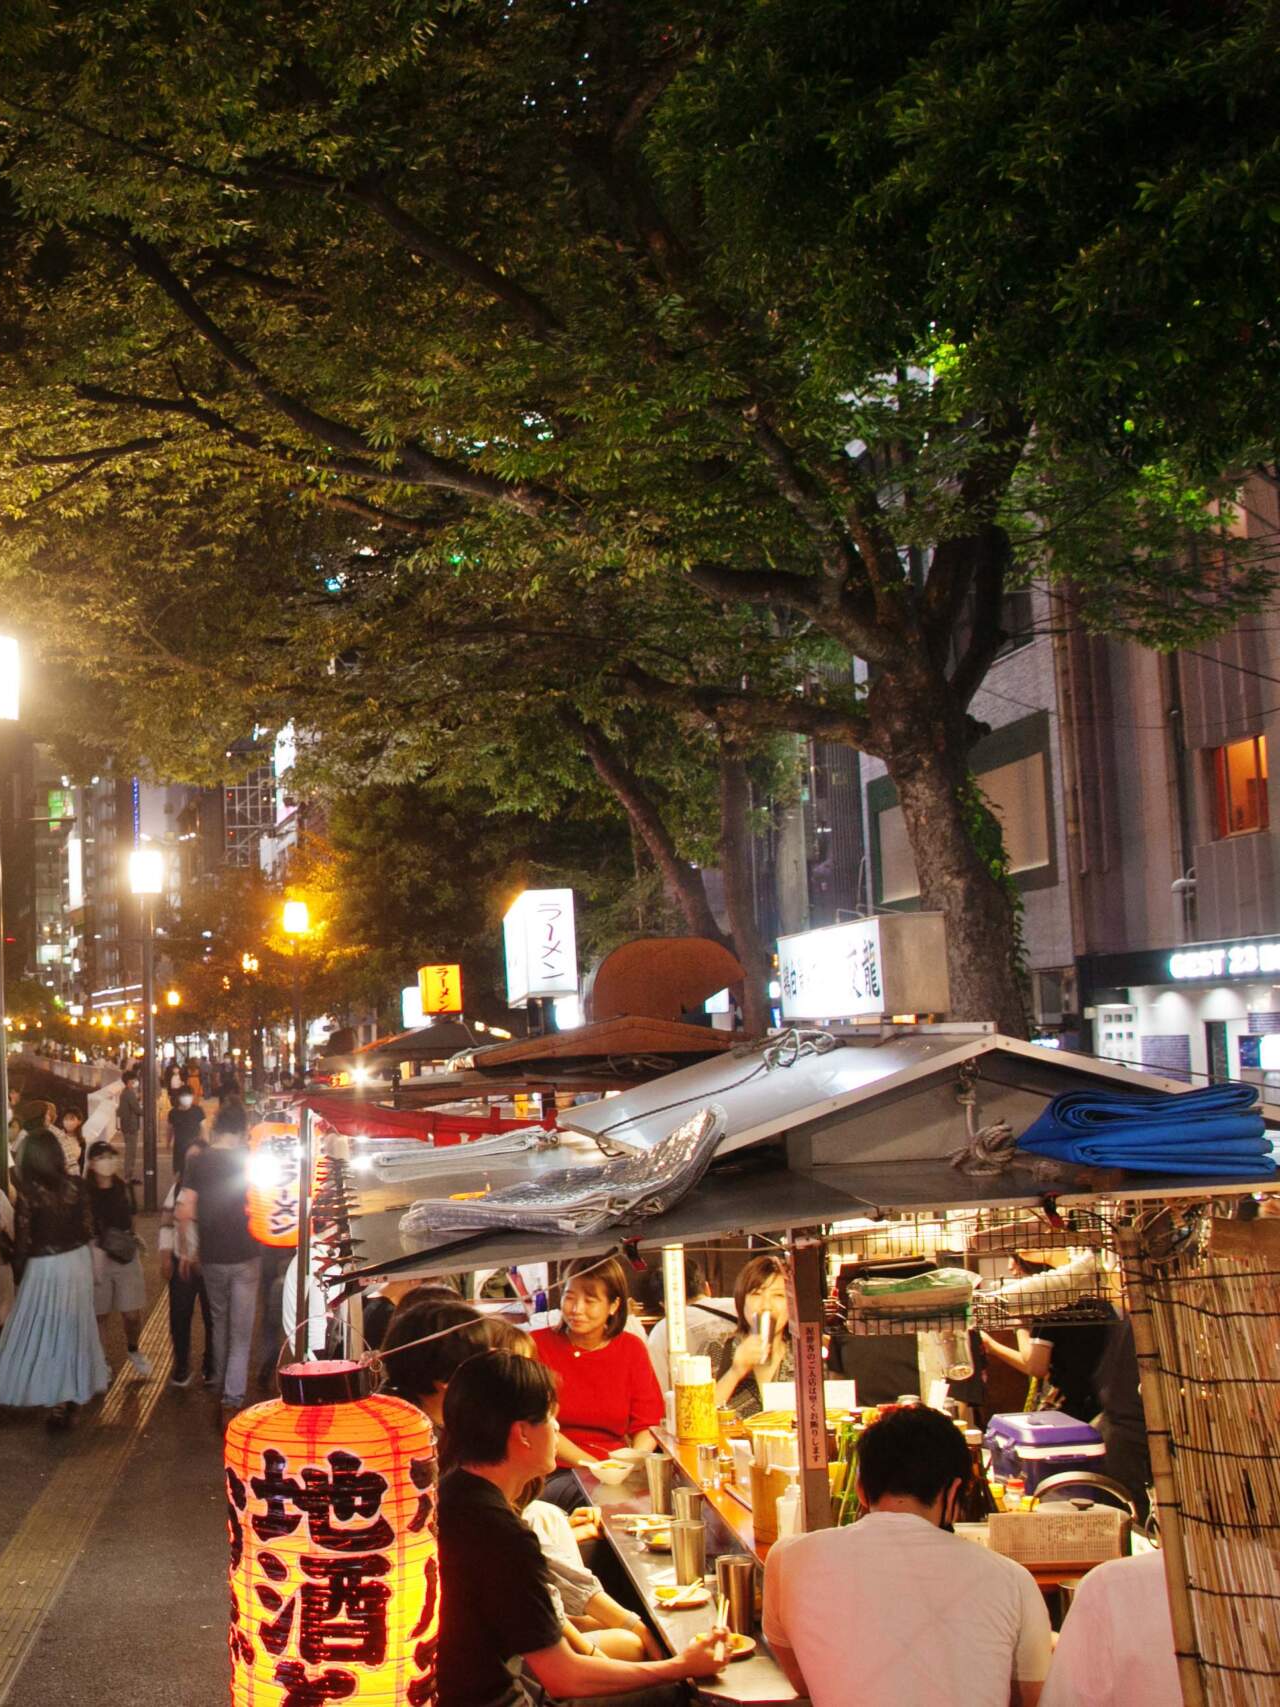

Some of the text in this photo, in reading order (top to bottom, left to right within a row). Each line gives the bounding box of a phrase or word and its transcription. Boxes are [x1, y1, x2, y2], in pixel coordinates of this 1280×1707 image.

[537, 903, 565, 980] ラーメン
[435, 967, 449, 1012] ラーメン
